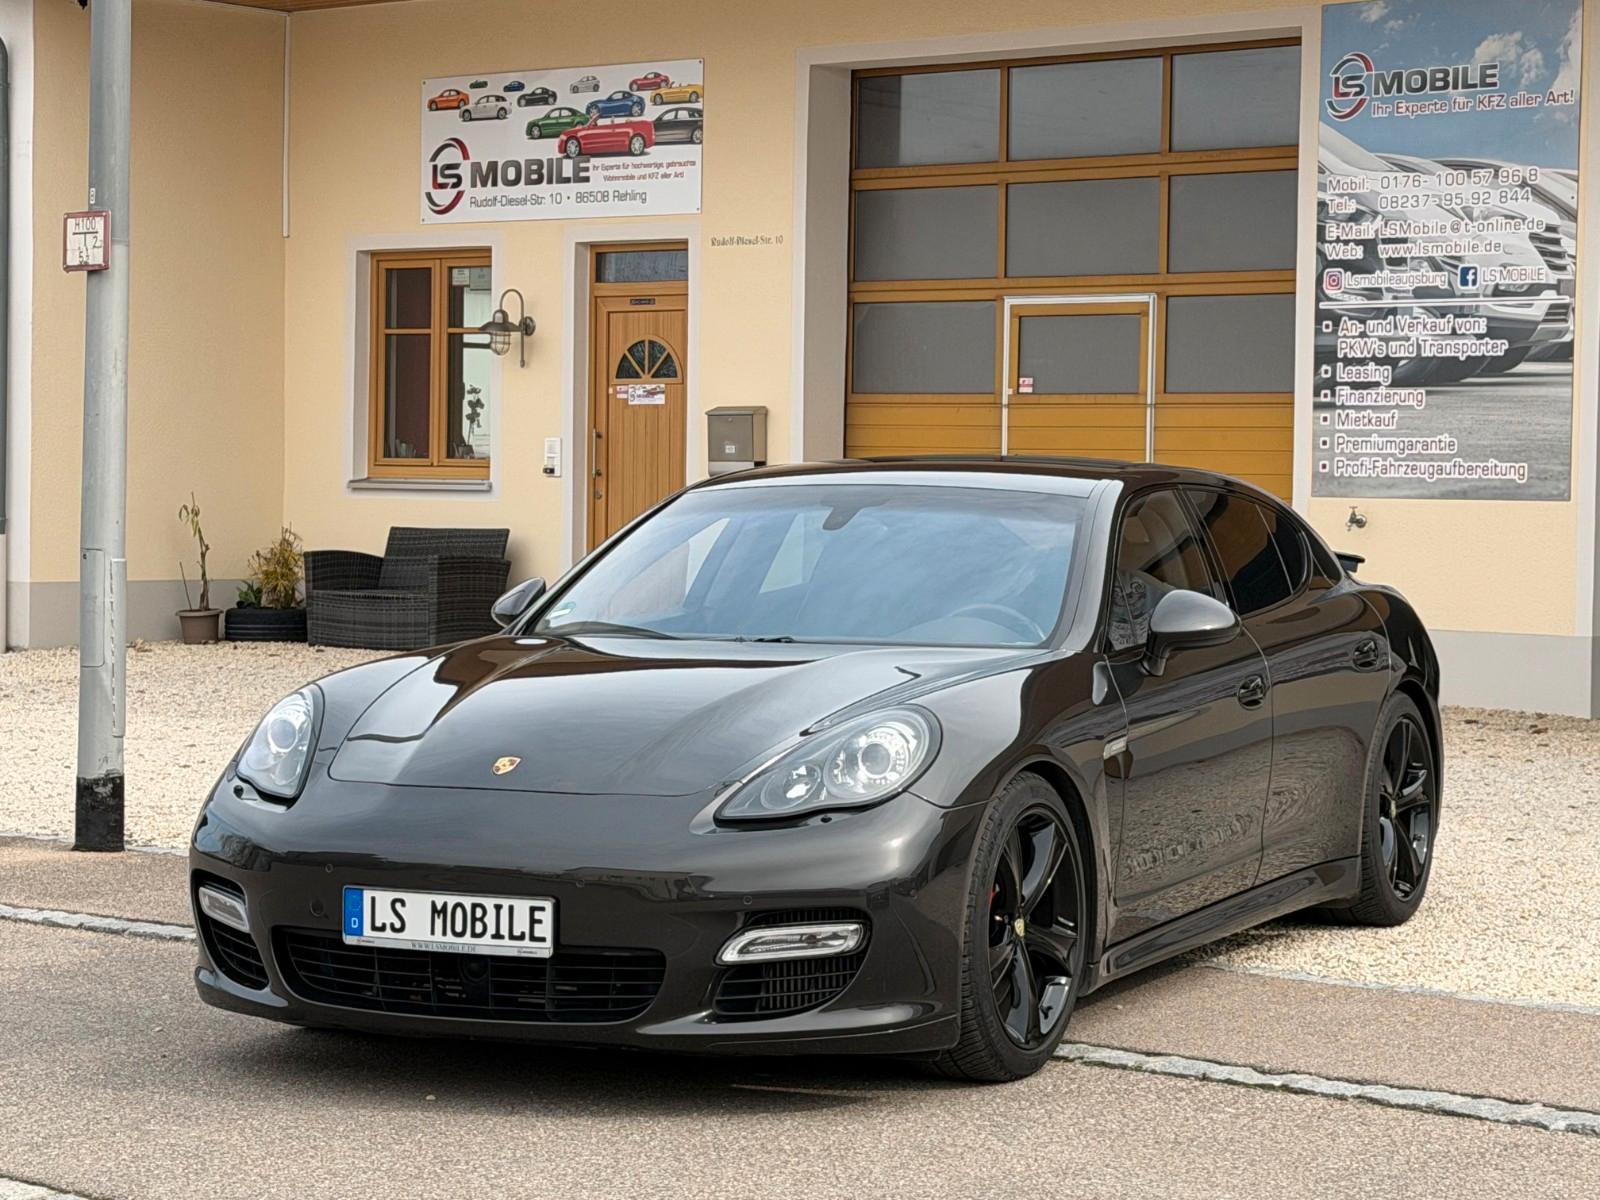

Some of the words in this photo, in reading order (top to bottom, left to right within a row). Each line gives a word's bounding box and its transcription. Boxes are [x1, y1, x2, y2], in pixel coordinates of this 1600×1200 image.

[1373, 64, 1498, 96] MOBILE
[1373, 103, 1392, 116] Ihr
[1396, 101, 1447, 118] Experte
[1452, 97, 1472, 110] für
[1478, 95, 1505, 109] KFZ
[1511, 92, 1541, 106] aller
[1546, 90, 1574, 104] Art!
[470, 157, 590, 188] MOBILE
[1328, 178, 1369, 192] Mobil:
[1436, 172, 1465, 186] 100
[1473, 170, 1492, 184] 57
[1500, 169, 1521, 183] 96
[1529, 168, 1538, 182] 8
[550, 192, 563, 205] 10
[575, 190, 609, 204] 86508
[612, 189, 647, 204] Rehling
[1328, 198, 1356, 211] Tel.:
[1444, 192, 1463, 206] 95
[1471, 191, 1491, 205] 92
[1499, 189, 1531, 204] 844
[1327, 223, 1374, 238] E-Mail:
[1327, 245, 1361, 258] Web:
[1379, 240, 1502, 256] www.lsmobile.de
[1482, 269, 1497, 283] LS
[1339, 318, 1364, 334] An-
[1367, 319, 1392, 333] und
[1398, 317, 1452, 332] Verkauf
[1456, 319, 1487, 332] von:
[1338, 341, 1385, 356] PKW's
[1391, 340, 1415, 355] und
[1421, 340, 1507, 358] Transporter
[1337, 365, 1391, 382] Leasing
[1336, 389, 1424, 407] Finanzierung
[1336, 412, 1396, 427] Mietkauf
[1336, 436, 1456, 455] Premiumgarantie
[1335, 460, 1526, 481] Profi-Fahrzeugaufbereitung
[351, 917, 359, 928] D
[370, 896, 406, 933] LS
[430, 899, 547, 943] MOBILE
